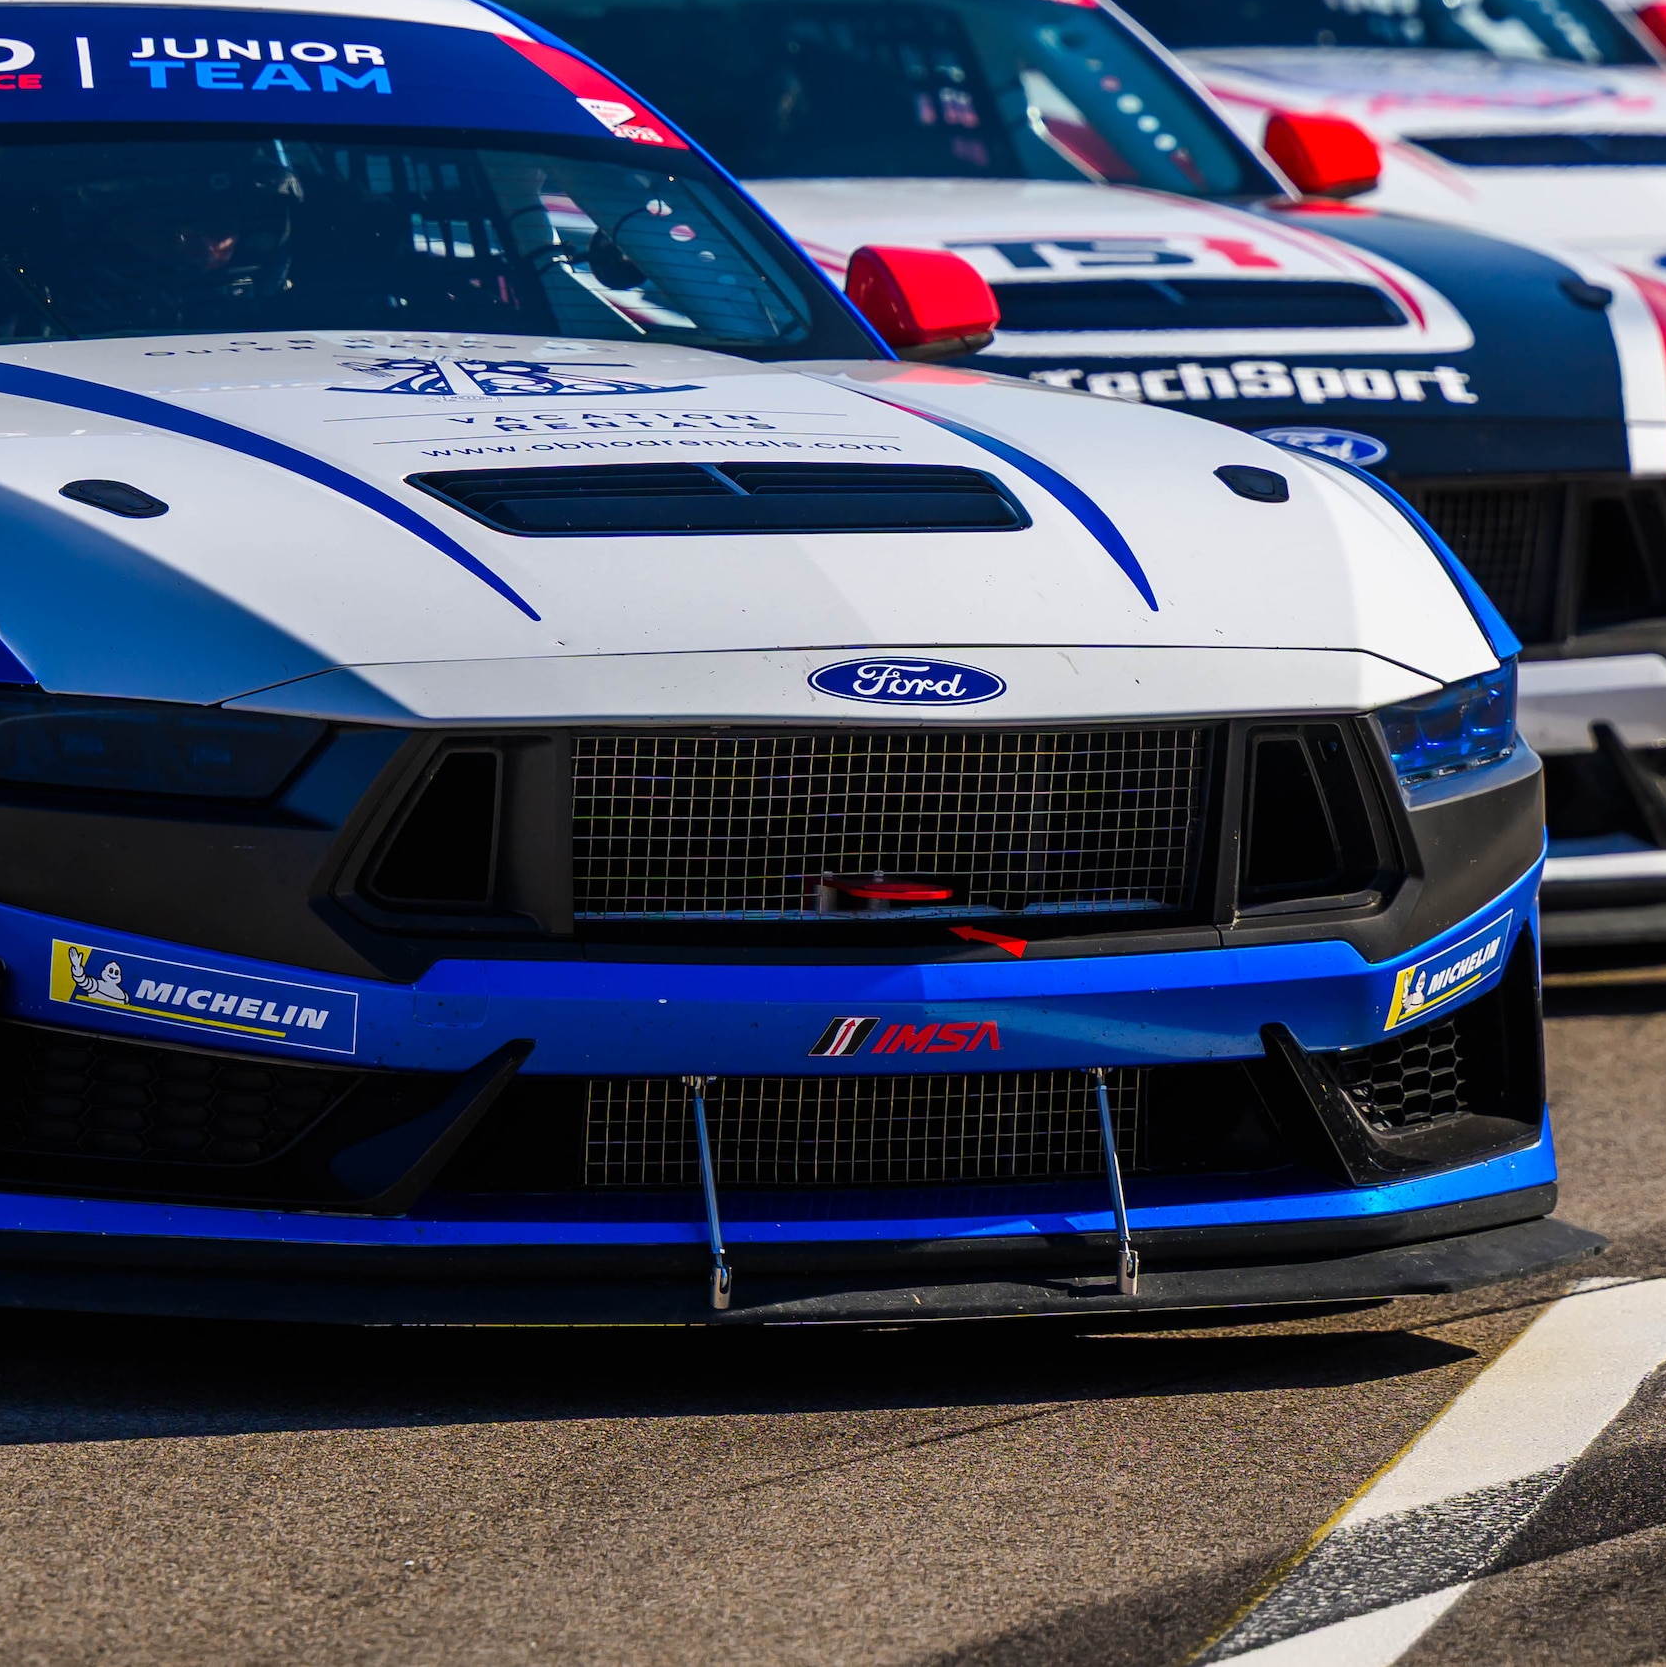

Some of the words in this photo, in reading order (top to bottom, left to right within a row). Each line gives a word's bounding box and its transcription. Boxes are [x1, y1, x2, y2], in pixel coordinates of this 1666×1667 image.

[132, 37, 386, 65] JUNIOR
[129, 60, 393, 94] TEAM
[446, 412, 761, 425] VACATION
[493, 421, 778, 432] RENTALS
[421, 438, 903, 457] www.obhoarentals.com
[852, 663, 967, 697] Ford
[1427, 936, 1501, 995] MICHELIN
[135, 979, 330, 1030] MICHELIN
[871, 1020, 1003, 1054] IMSA
